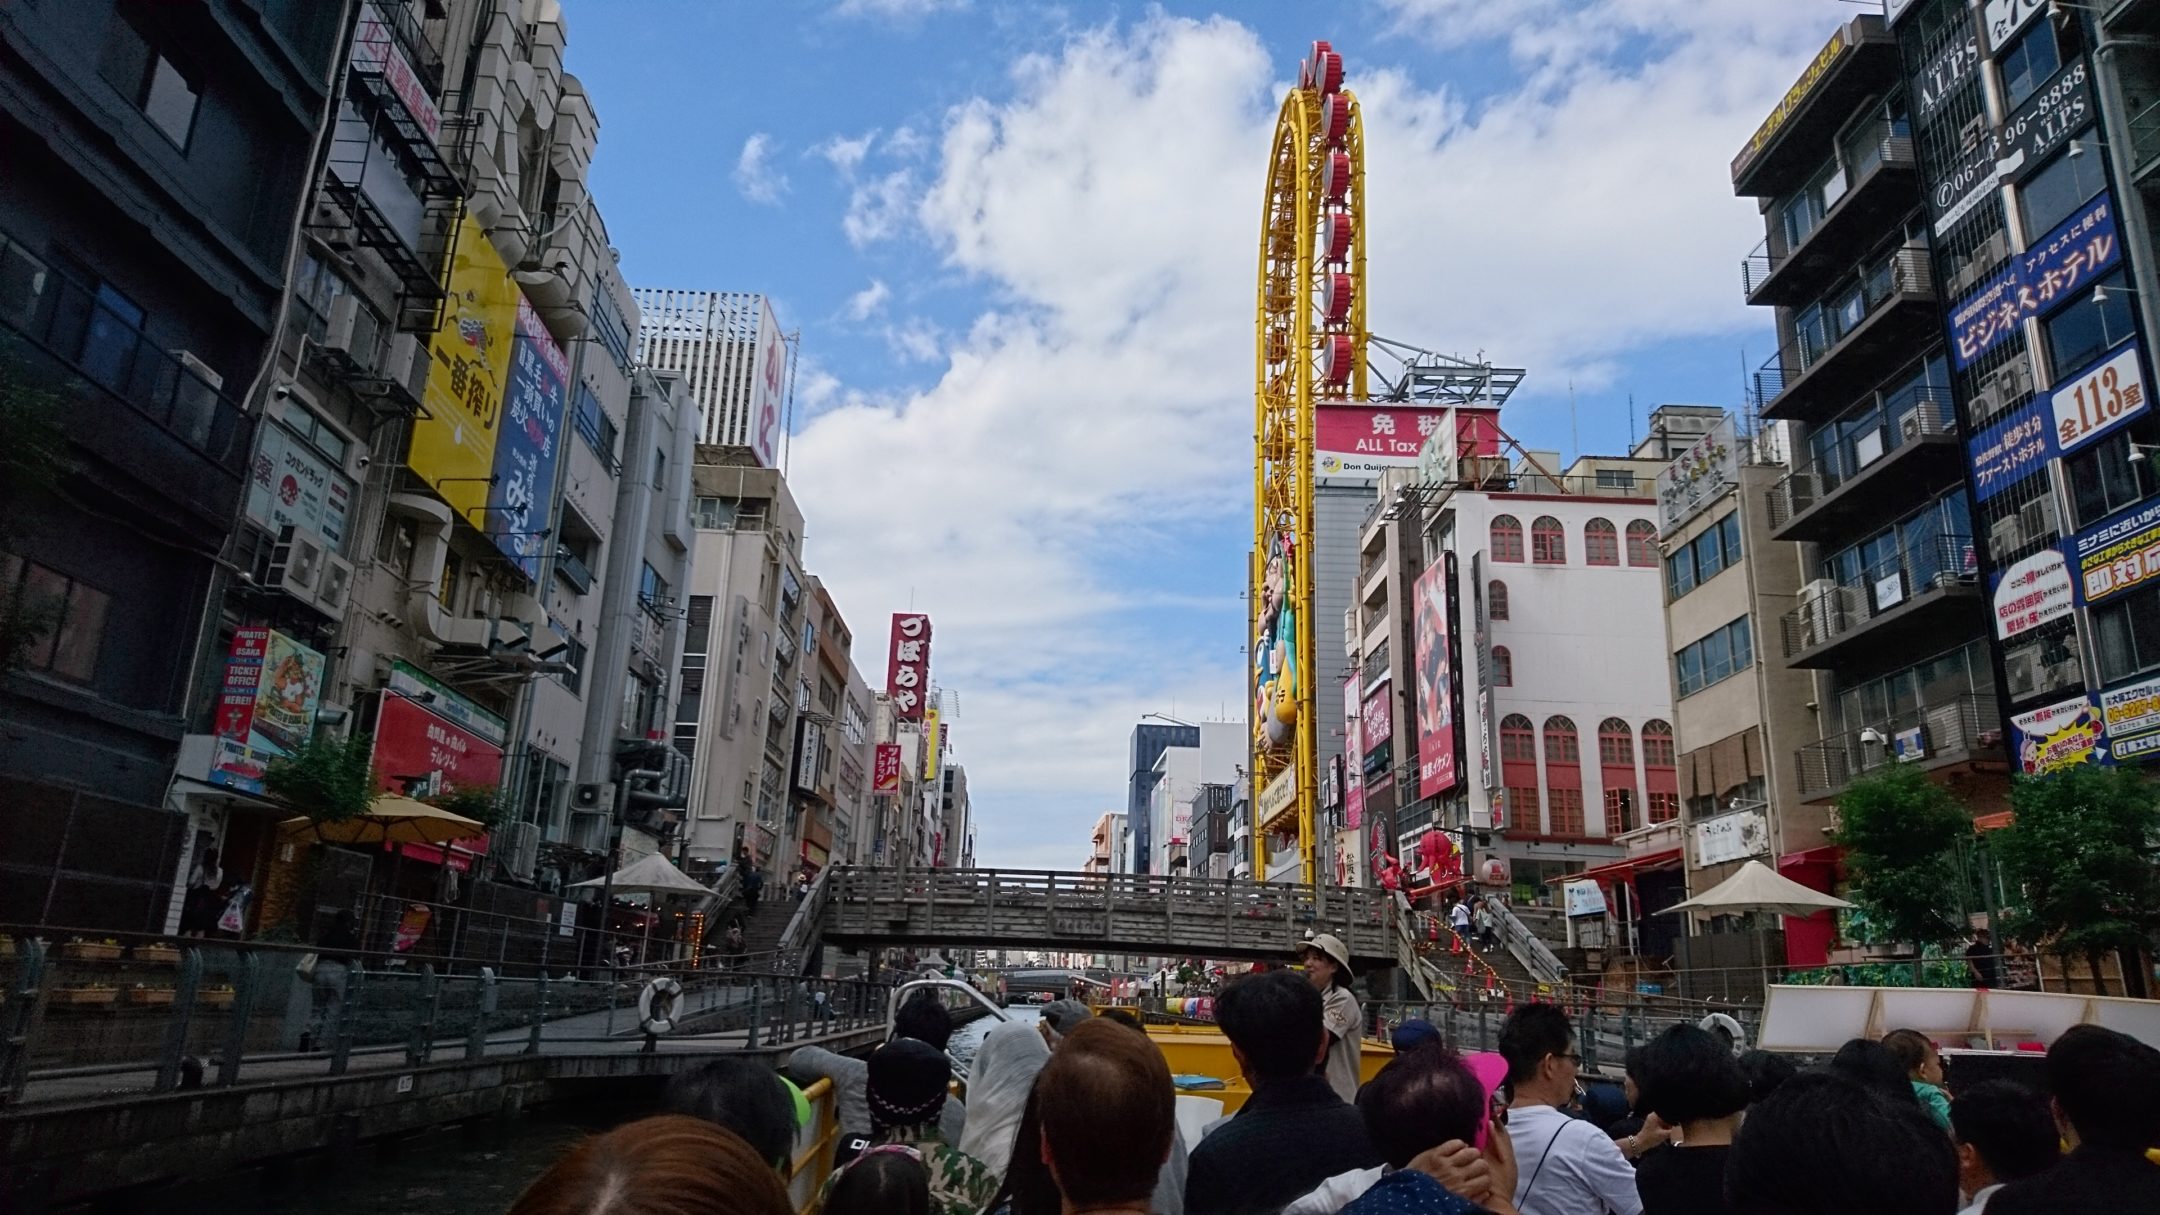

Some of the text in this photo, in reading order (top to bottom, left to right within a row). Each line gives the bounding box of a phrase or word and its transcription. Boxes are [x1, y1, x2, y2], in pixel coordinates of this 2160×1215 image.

[1920, 36, 1978, 116] ALPS
[2033, 96, 2085, 154] ALPS
[2025, 205, 2107, 273] アクセスに便利
[1958, 234, 2113, 359] ビジネスホテル
[436, 345, 497, 430] 一番搾り
[515, 374, 556, 433] 一頭買いの
[2060, 366, 2143, 445] 全113室
[1356, 439, 1418, 453] ALL Tax
[2003, 416, 2042, 451] 徒歩3分
[255, 454, 274, 489] 薬
[285, 452, 324, 488] コクミンドラッグ
[1343, 463, 1362, 471] Don
[1977, 440, 2045, 488] ファーストホテル
[235, 648, 261, 656] OSAKA
[236, 630, 268, 640] PIRATES
[245, 639, 255, 647] OF
[228, 676, 258, 686] OFFICE
[229, 666, 260, 676] TICKET
[895, 615, 926, 712] づぼらや
[876, 752, 888, 782] ドラッグ
[886, 747, 899, 775] ツルハ
